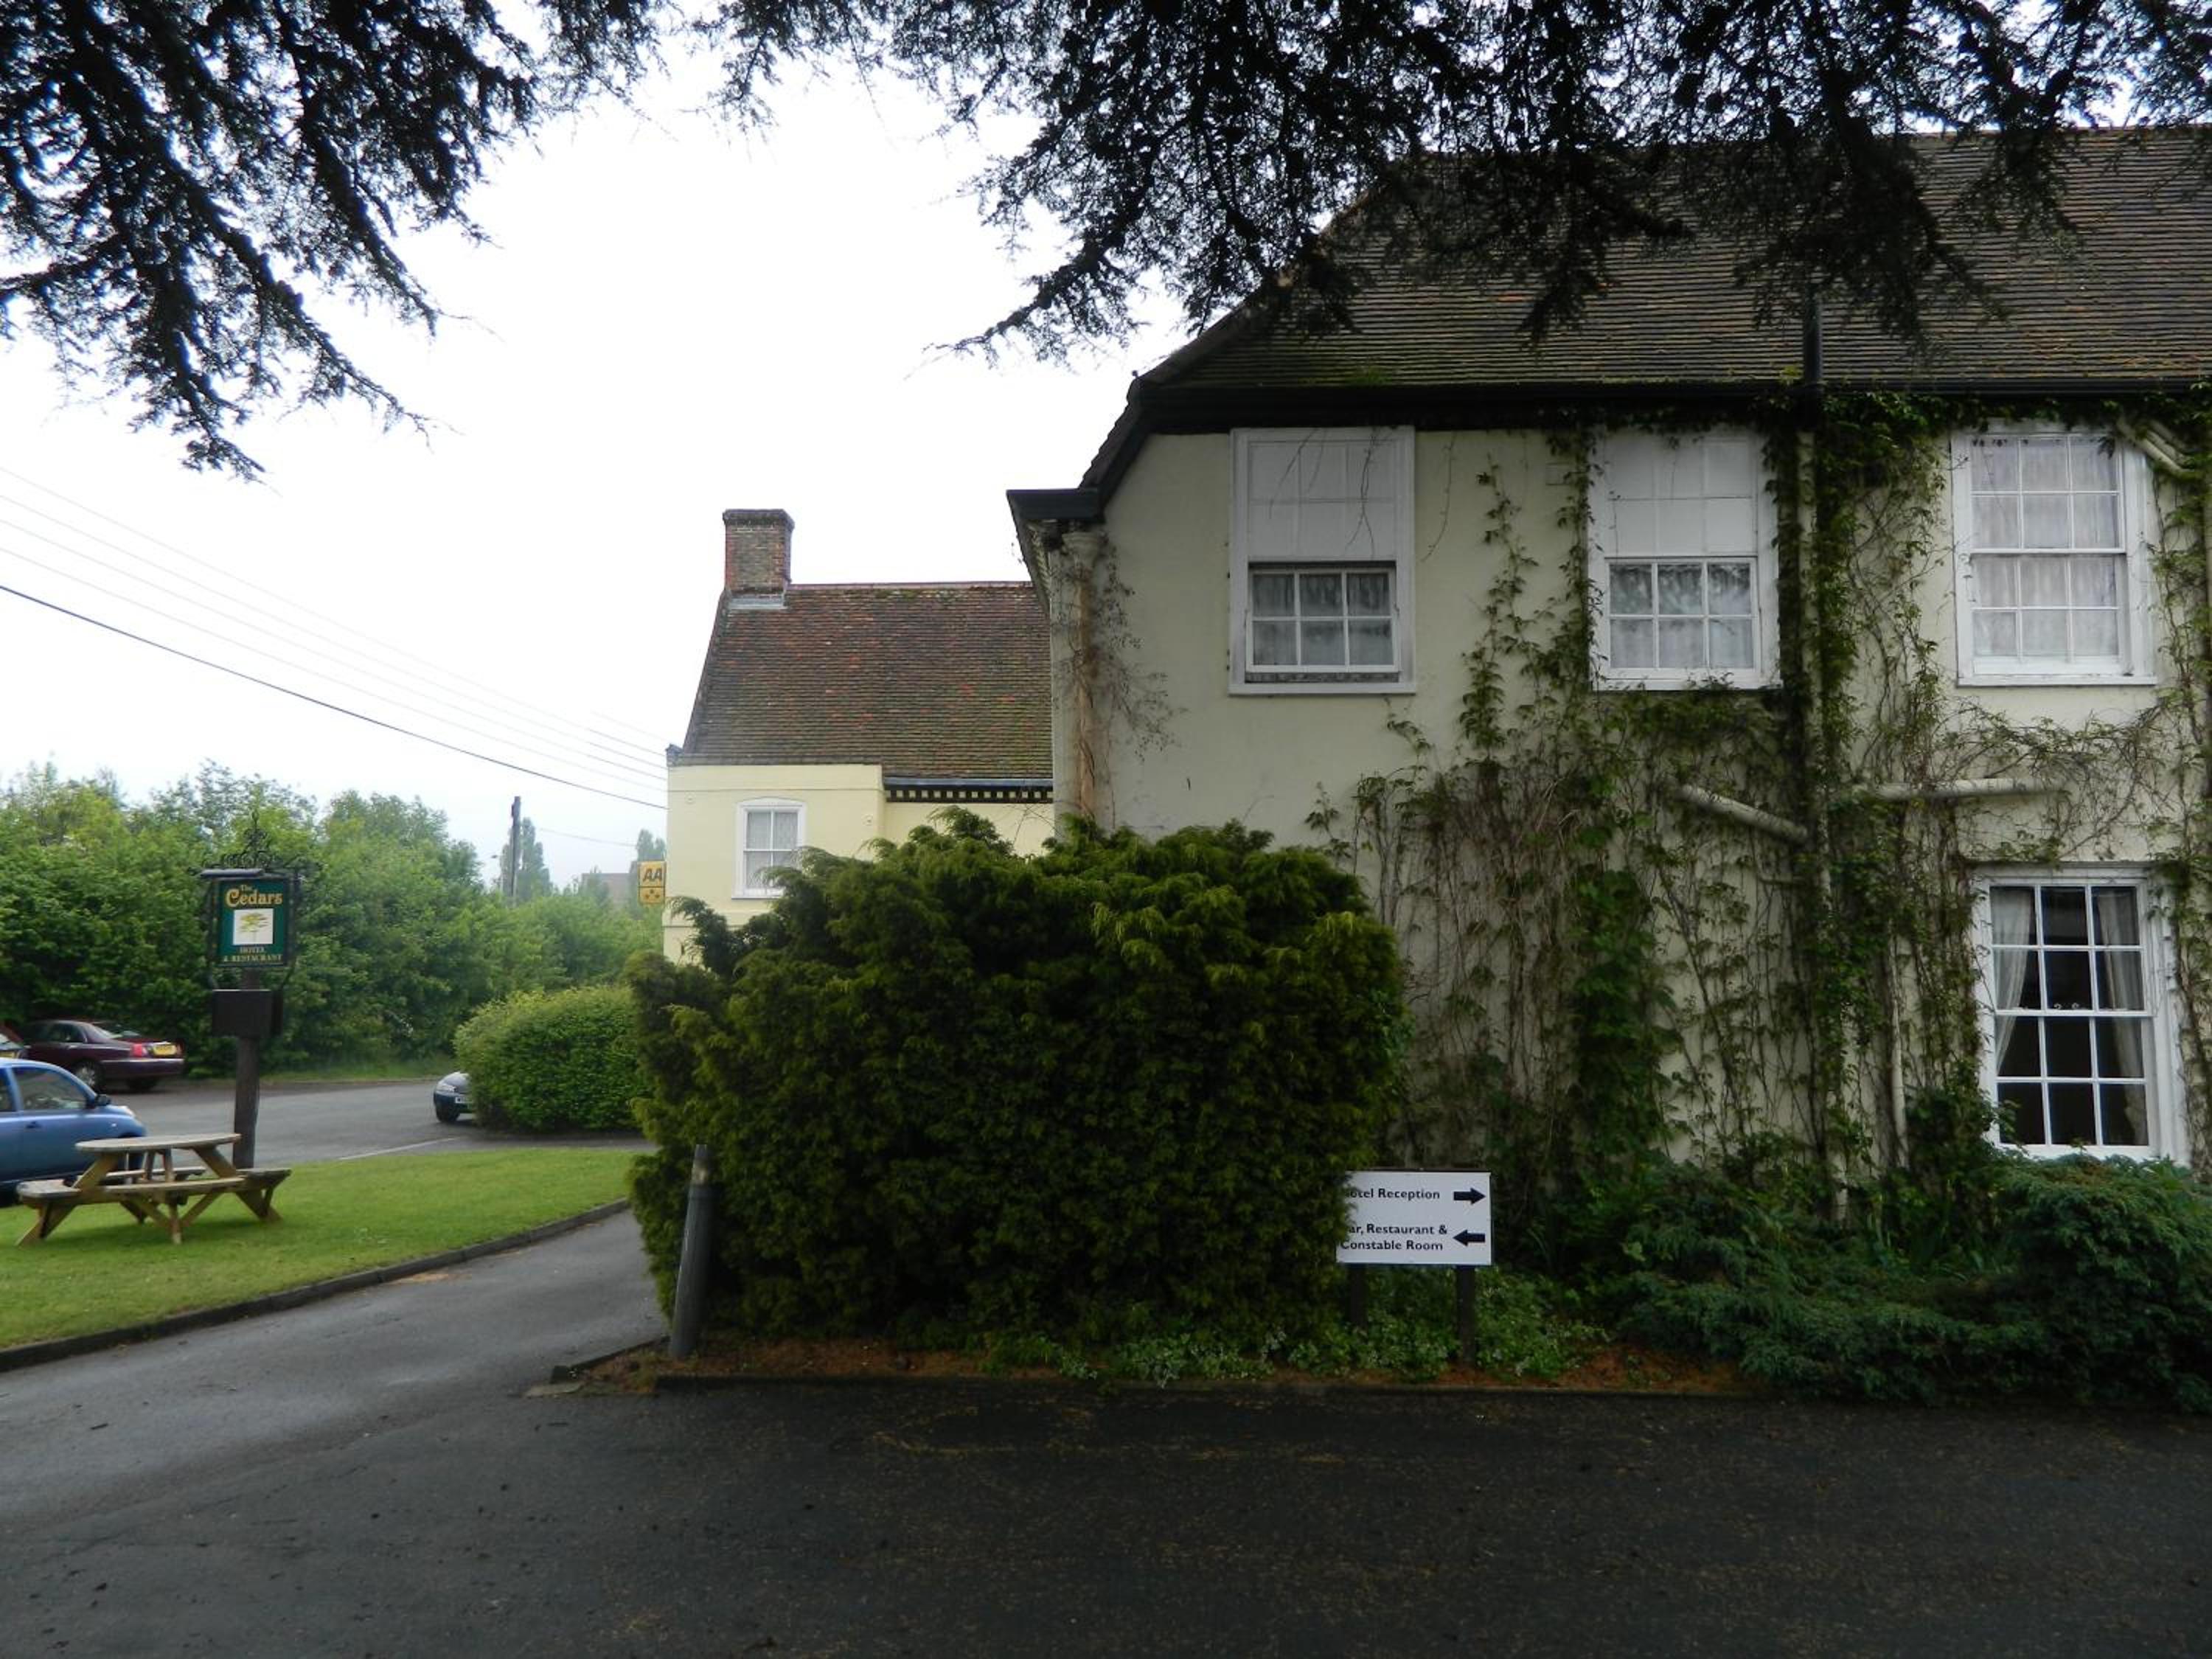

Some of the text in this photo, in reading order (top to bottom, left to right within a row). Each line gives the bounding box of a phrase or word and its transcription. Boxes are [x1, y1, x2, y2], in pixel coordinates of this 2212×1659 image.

[642, 868, 663, 881] AA
[226, 888, 283, 907] Cedars
[1378, 1188, 1440, 1200] Reception
[1366, 1223, 1435, 1234] Restaurant
[1439, 1224, 1448, 1235] &
[1340, 1239, 1443, 1251] Constable Room
